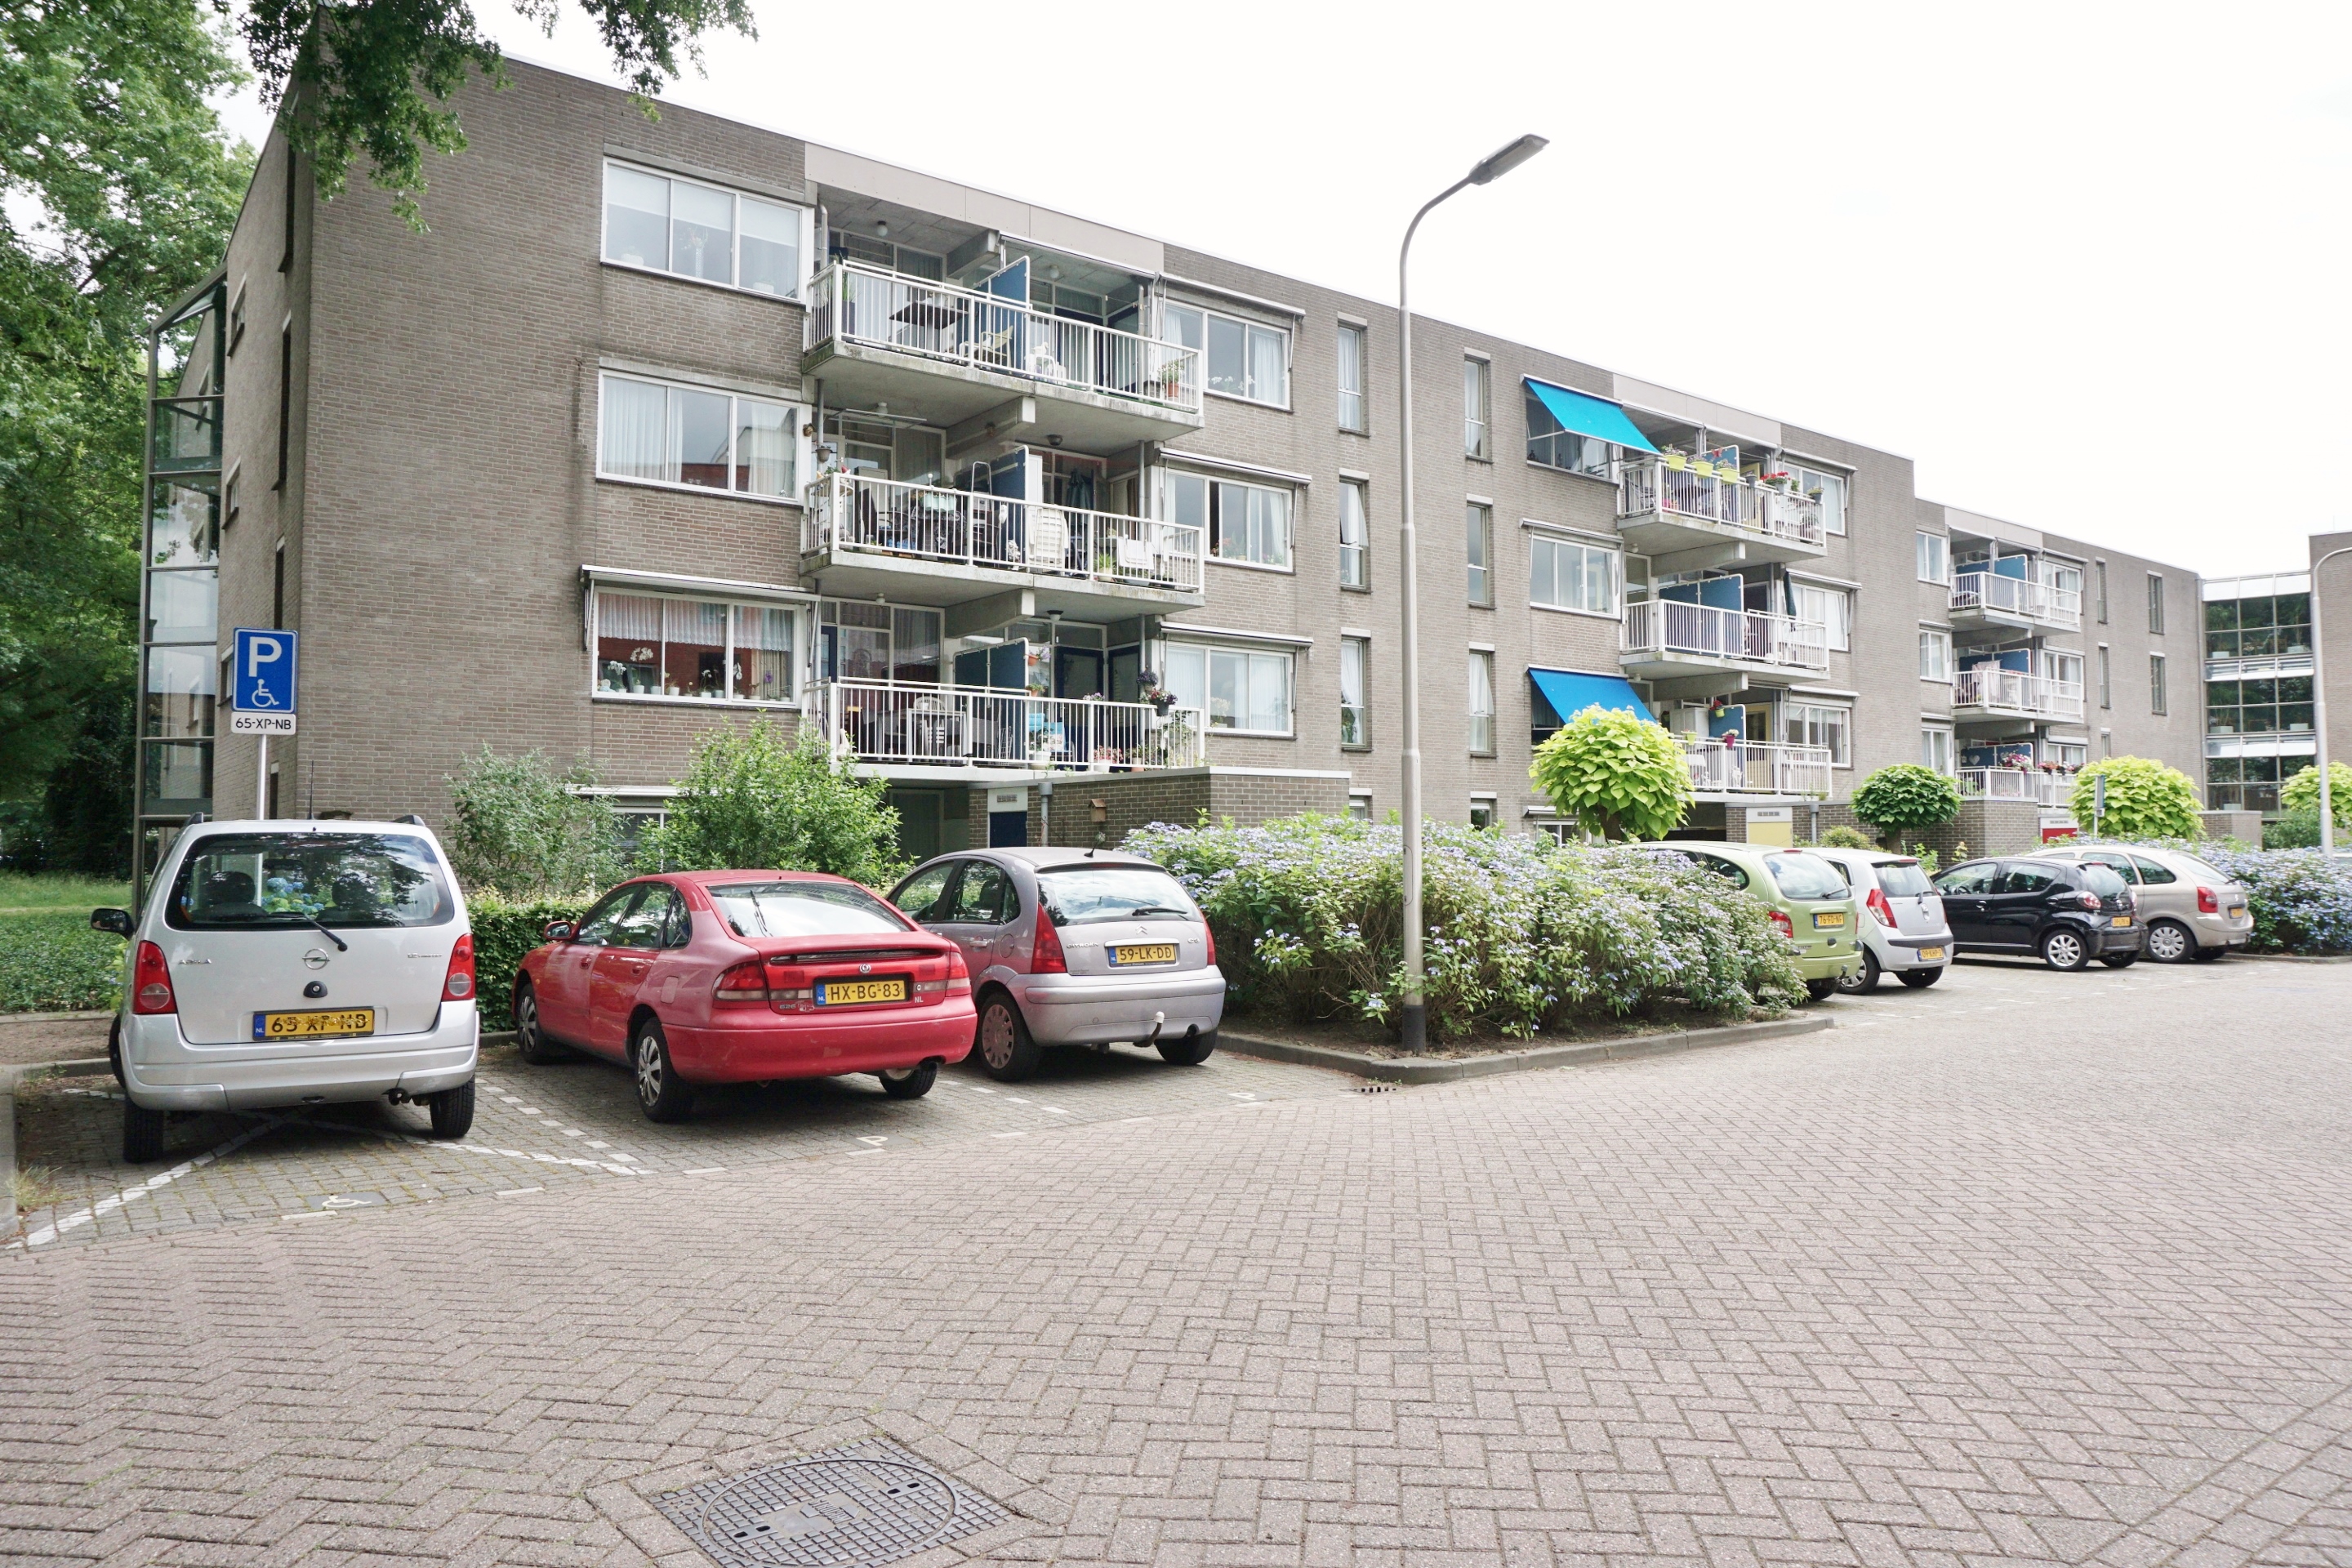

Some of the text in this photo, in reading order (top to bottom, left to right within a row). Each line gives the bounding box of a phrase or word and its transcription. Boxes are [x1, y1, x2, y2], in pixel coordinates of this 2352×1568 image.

[248, 636, 283, 677] P
[235, 717, 292, 730] 65-XP-NB
[1120, 947, 1172, 961] 59-LK-DD
[830, 983, 900, 1001] HX-BG-83
[856, 1135, 889, 1147] P
